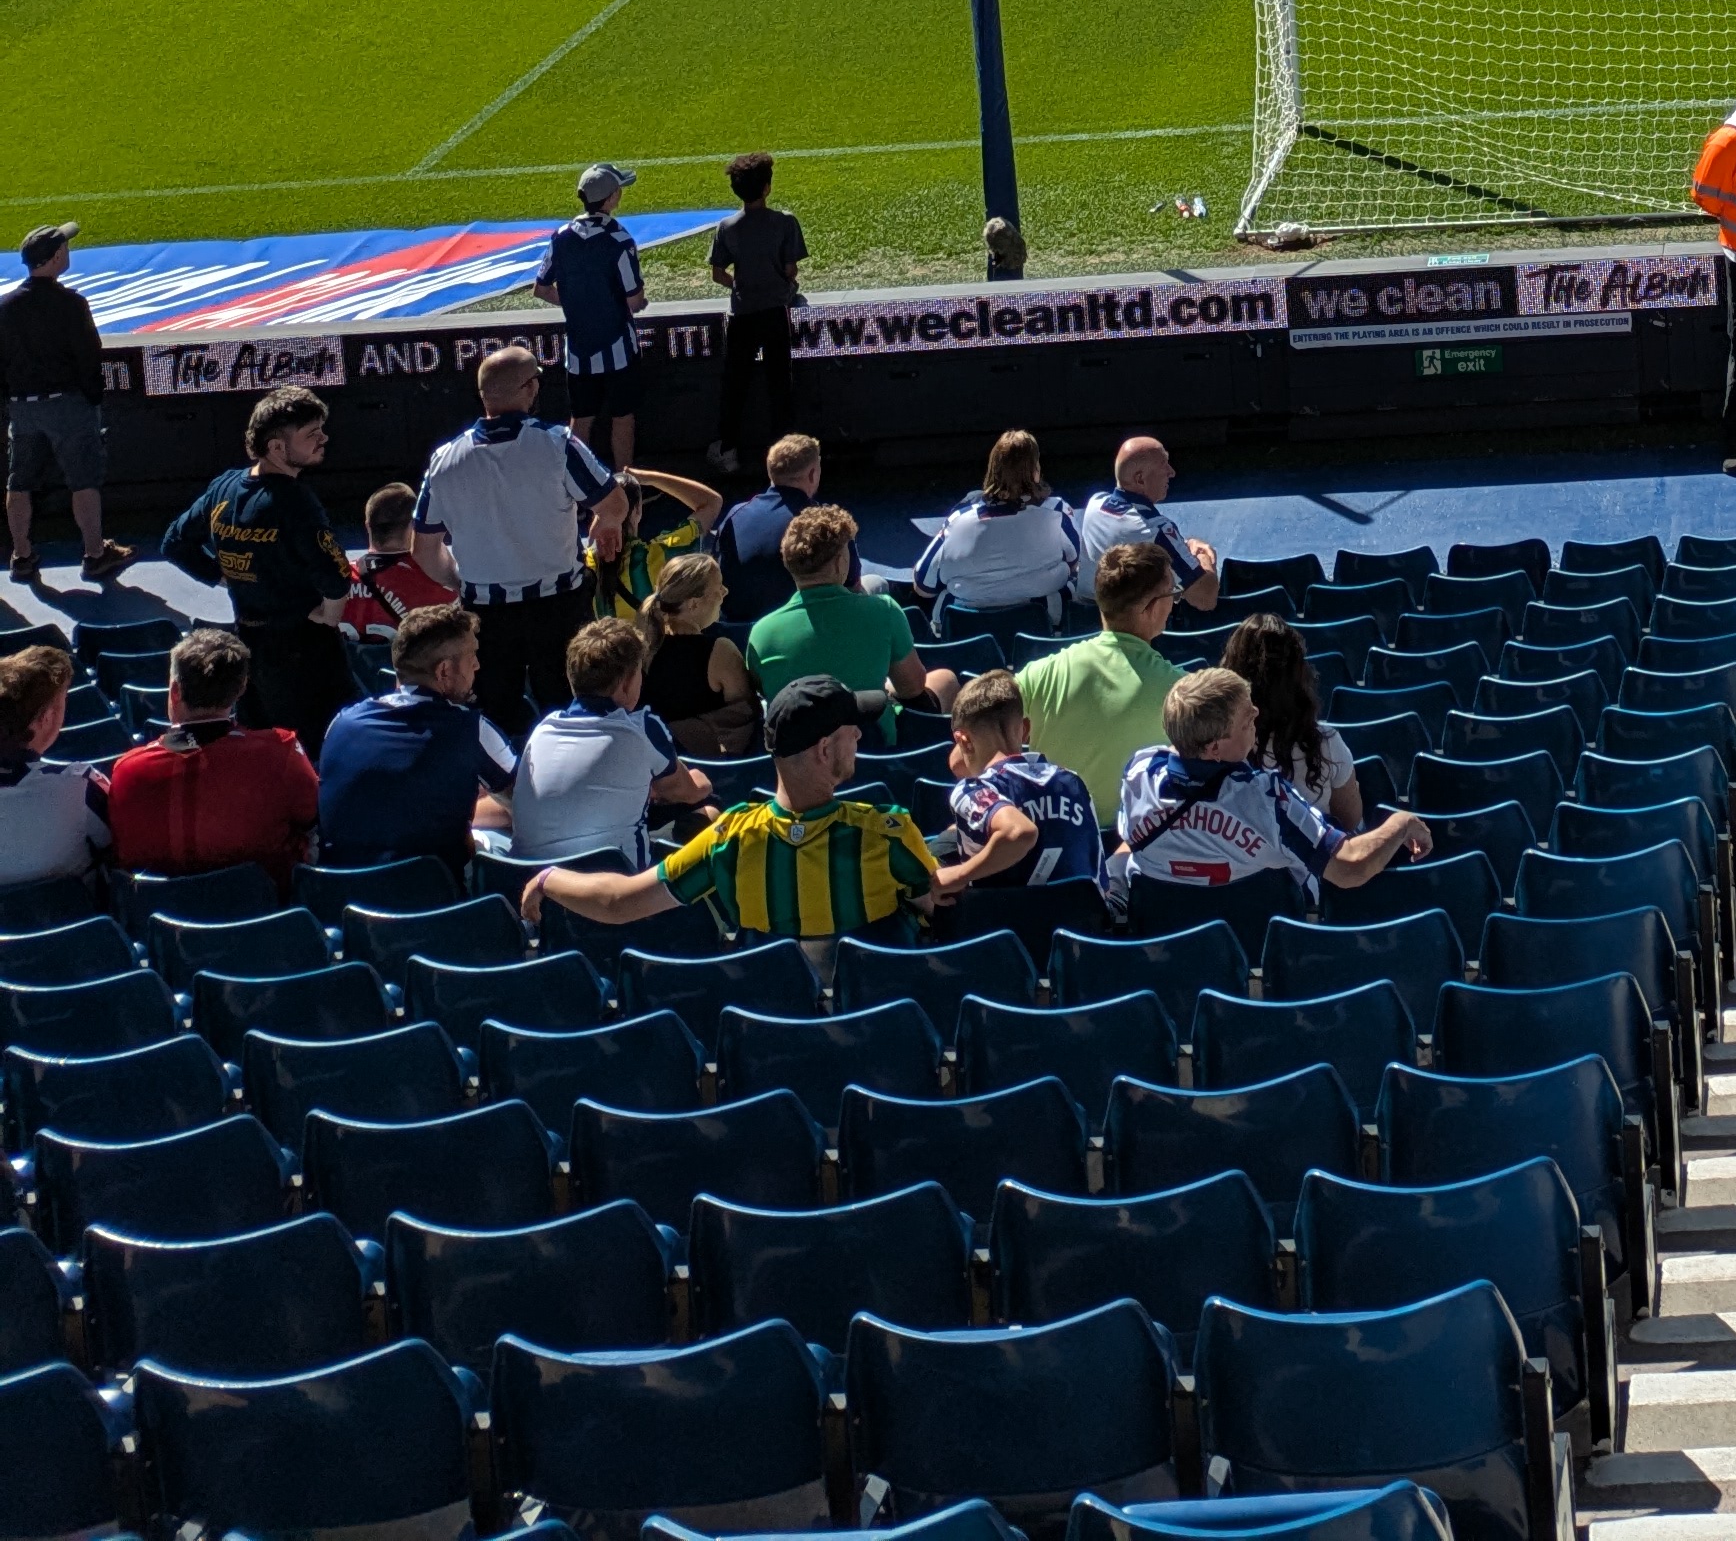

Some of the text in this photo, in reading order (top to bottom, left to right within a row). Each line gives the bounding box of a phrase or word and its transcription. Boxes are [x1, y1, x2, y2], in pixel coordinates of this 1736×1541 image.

[1302, 287, 1368, 320] we
[1377, 274, 1500, 316] clean
[1293, 317, 1630, 344] ENTERING THE PLAYING AREA IS AN OFFENCE WHICH COULD RESULT IN PROSECUTION
[358, 337, 443, 377] AND
[667, 325, 712, 359] IT!
[1445, 347, 1496, 360] Emergency
[1458, 358, 1486, 373] exit
[209, 500, 280, 544] Impreza
